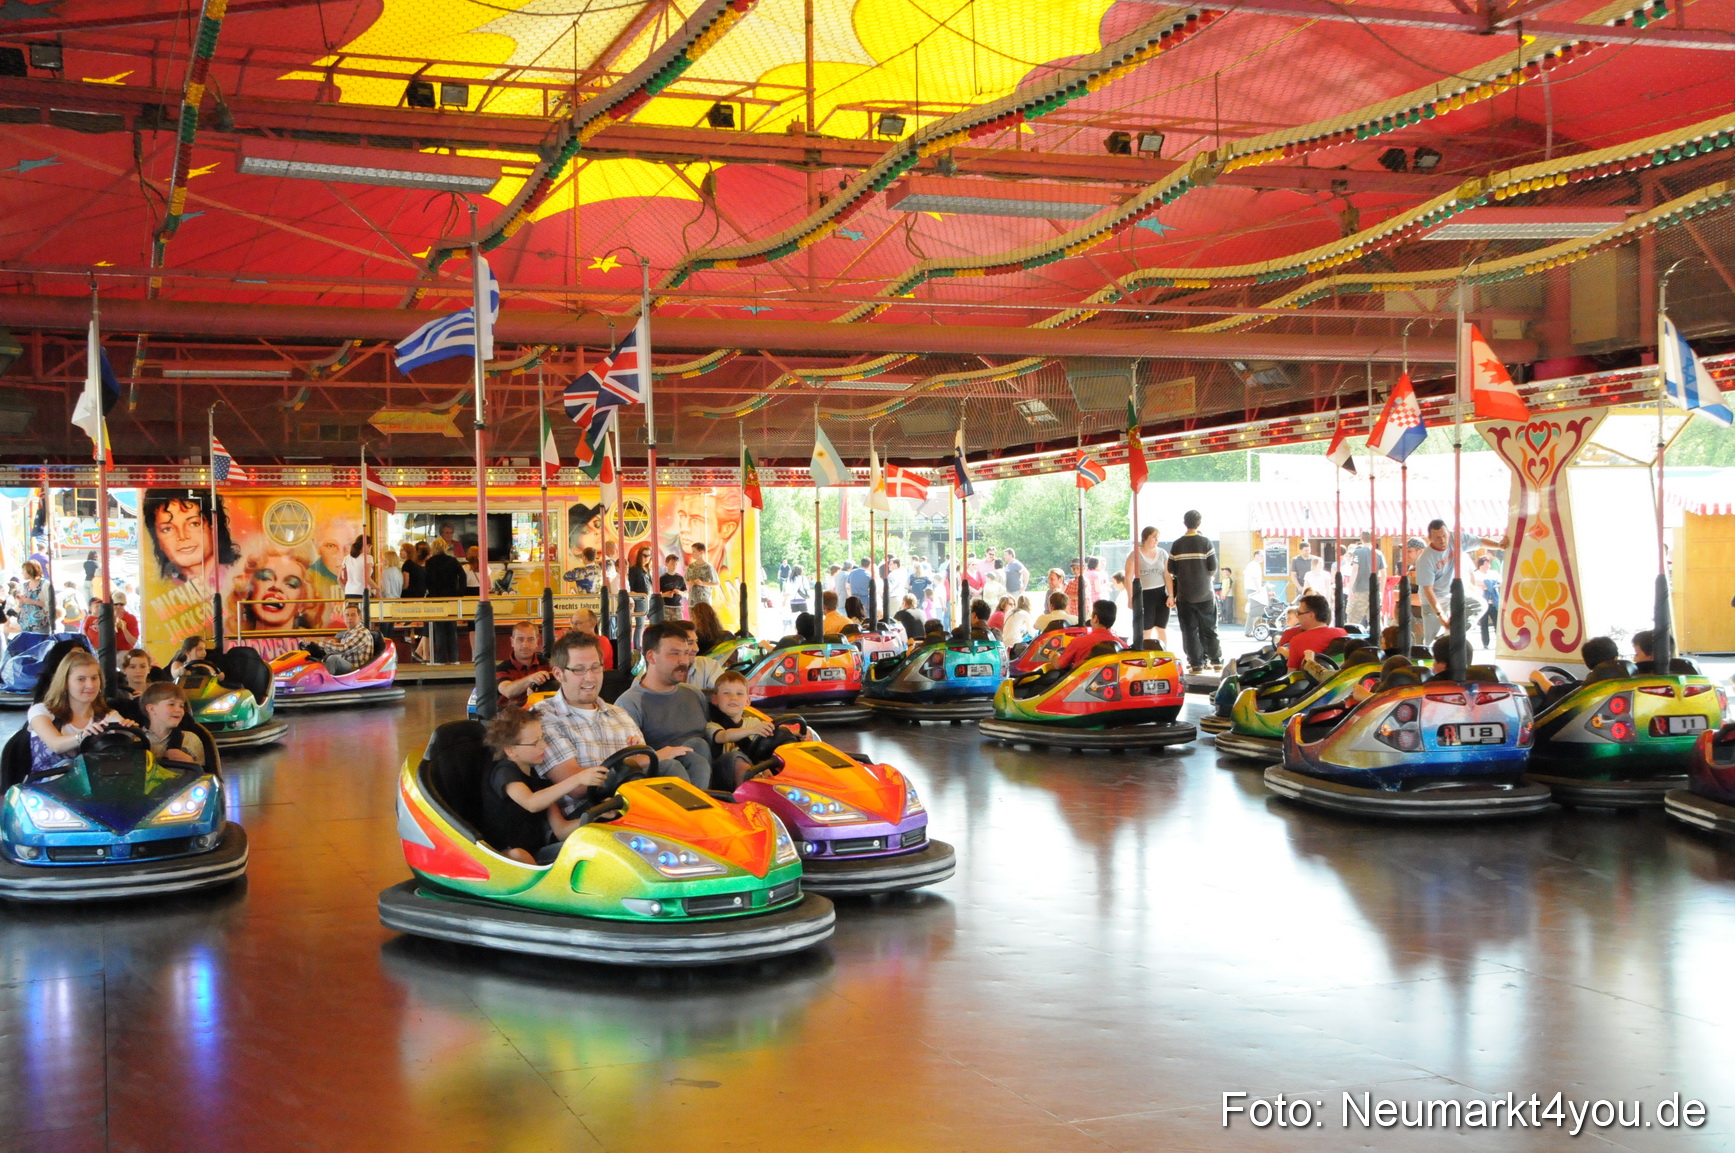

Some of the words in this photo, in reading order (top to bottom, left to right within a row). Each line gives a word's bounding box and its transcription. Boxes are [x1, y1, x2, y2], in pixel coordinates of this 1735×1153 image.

[558, 602, 579, 610] rechts
[580, 602, 600, 610] fahren
[1681, 718, 1696, 729] 11
[1469, 726, 1494, 738] 18
